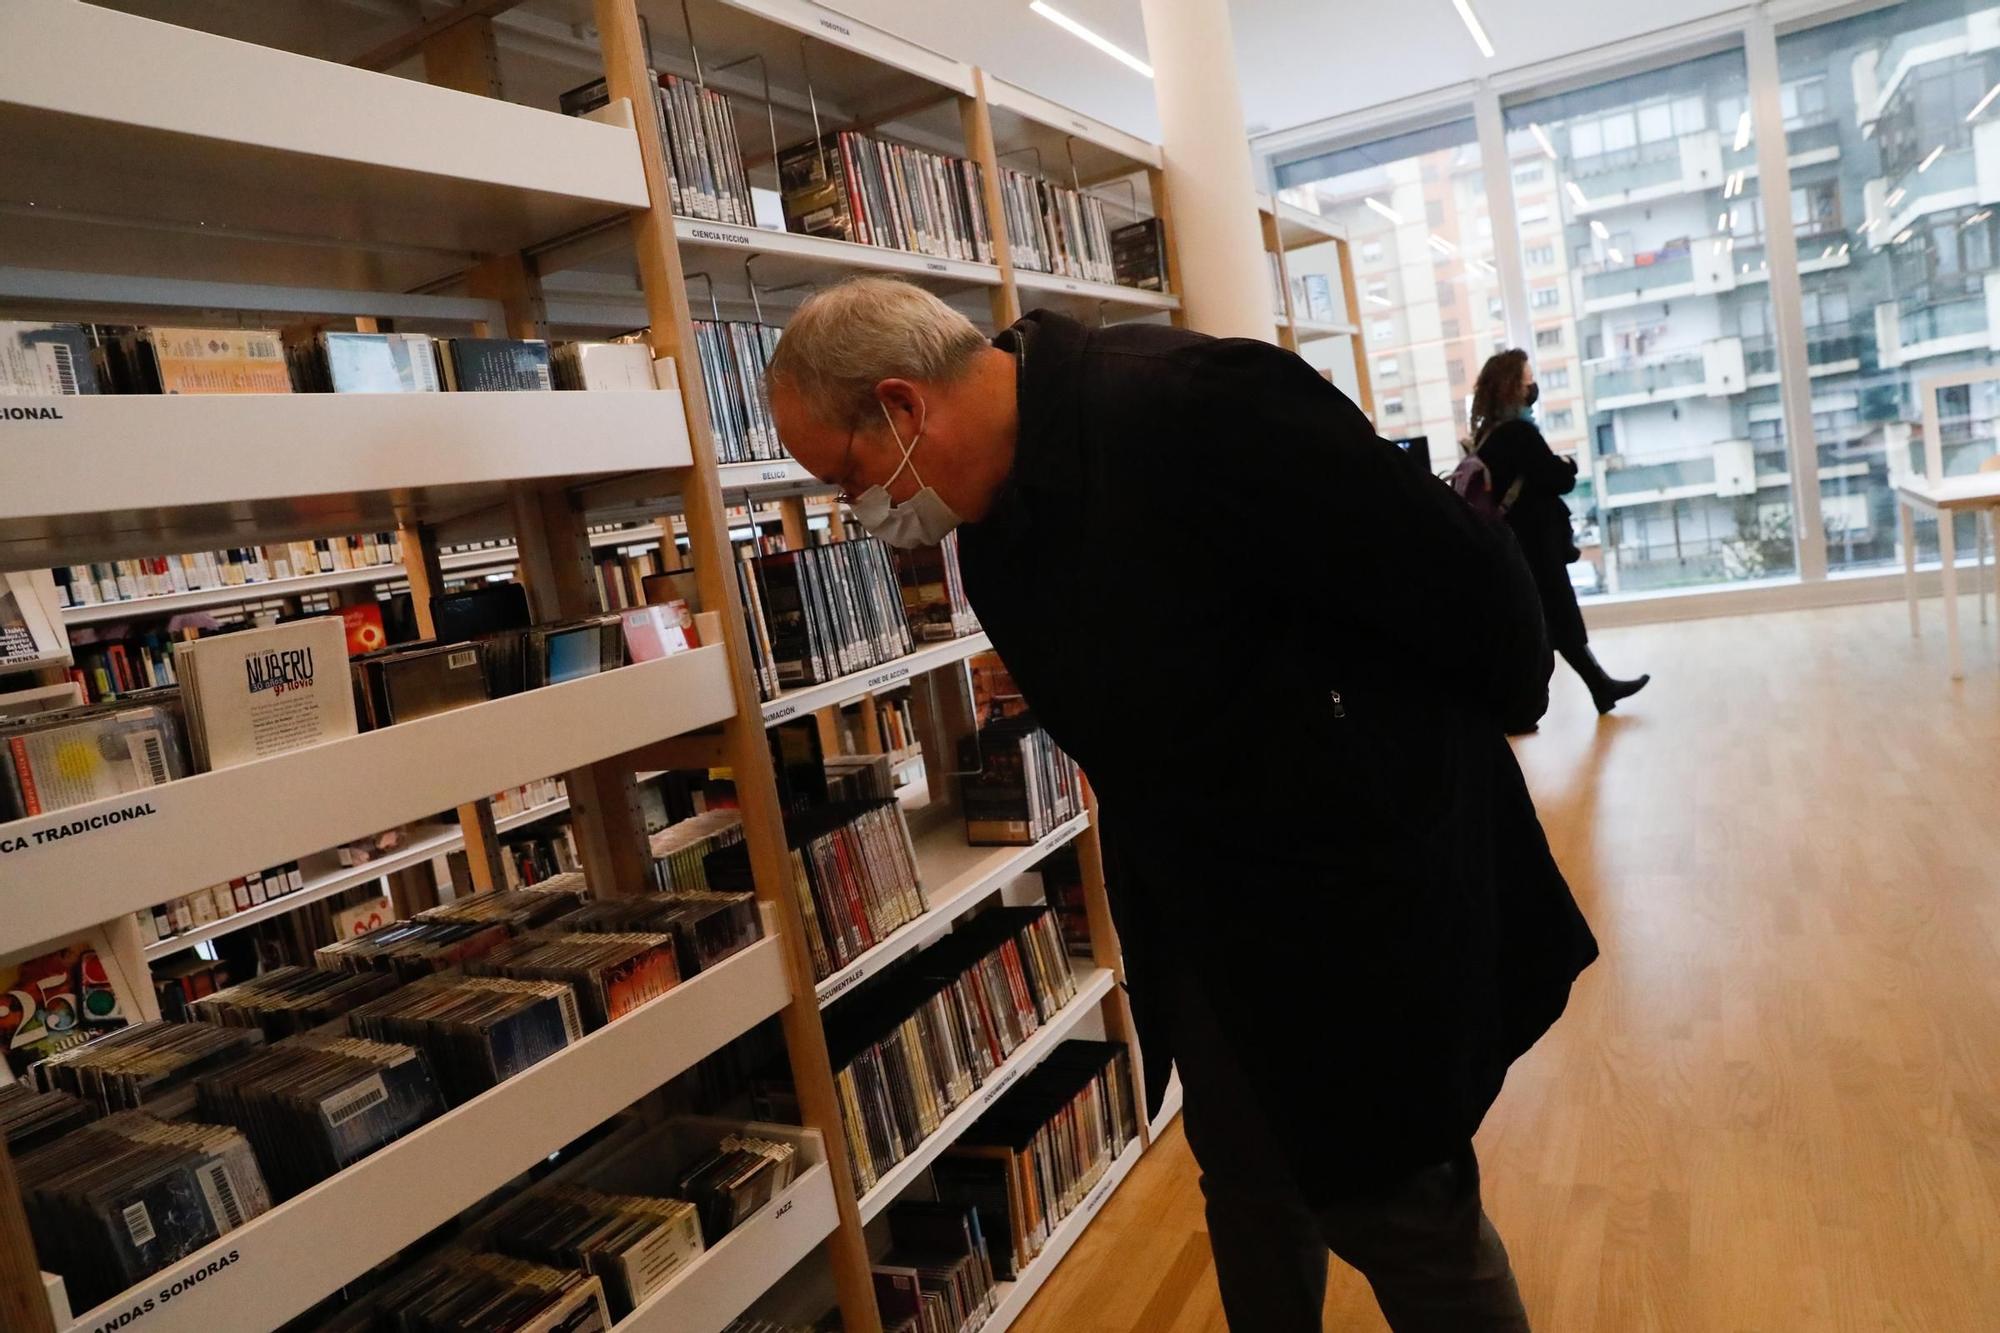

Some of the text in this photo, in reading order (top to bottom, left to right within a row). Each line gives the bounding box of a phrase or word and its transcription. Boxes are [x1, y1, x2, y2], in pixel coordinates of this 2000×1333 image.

[692, 229, 721, 241] CIENCIA
[0, 407, 64, 420] IONAL
[6, 654, 40, 665] PRENSA
[868, 678, 882, 687] CINE
[882, 675, 890, 683] DE
[32, 803, 157, 845] TRADICIONAL
[816, 968, 864, 1005] DOCUMENTALES
[775, 1200, 793, 1219] JAZZ
[159, 1250, 240, 1303] SONORAS
